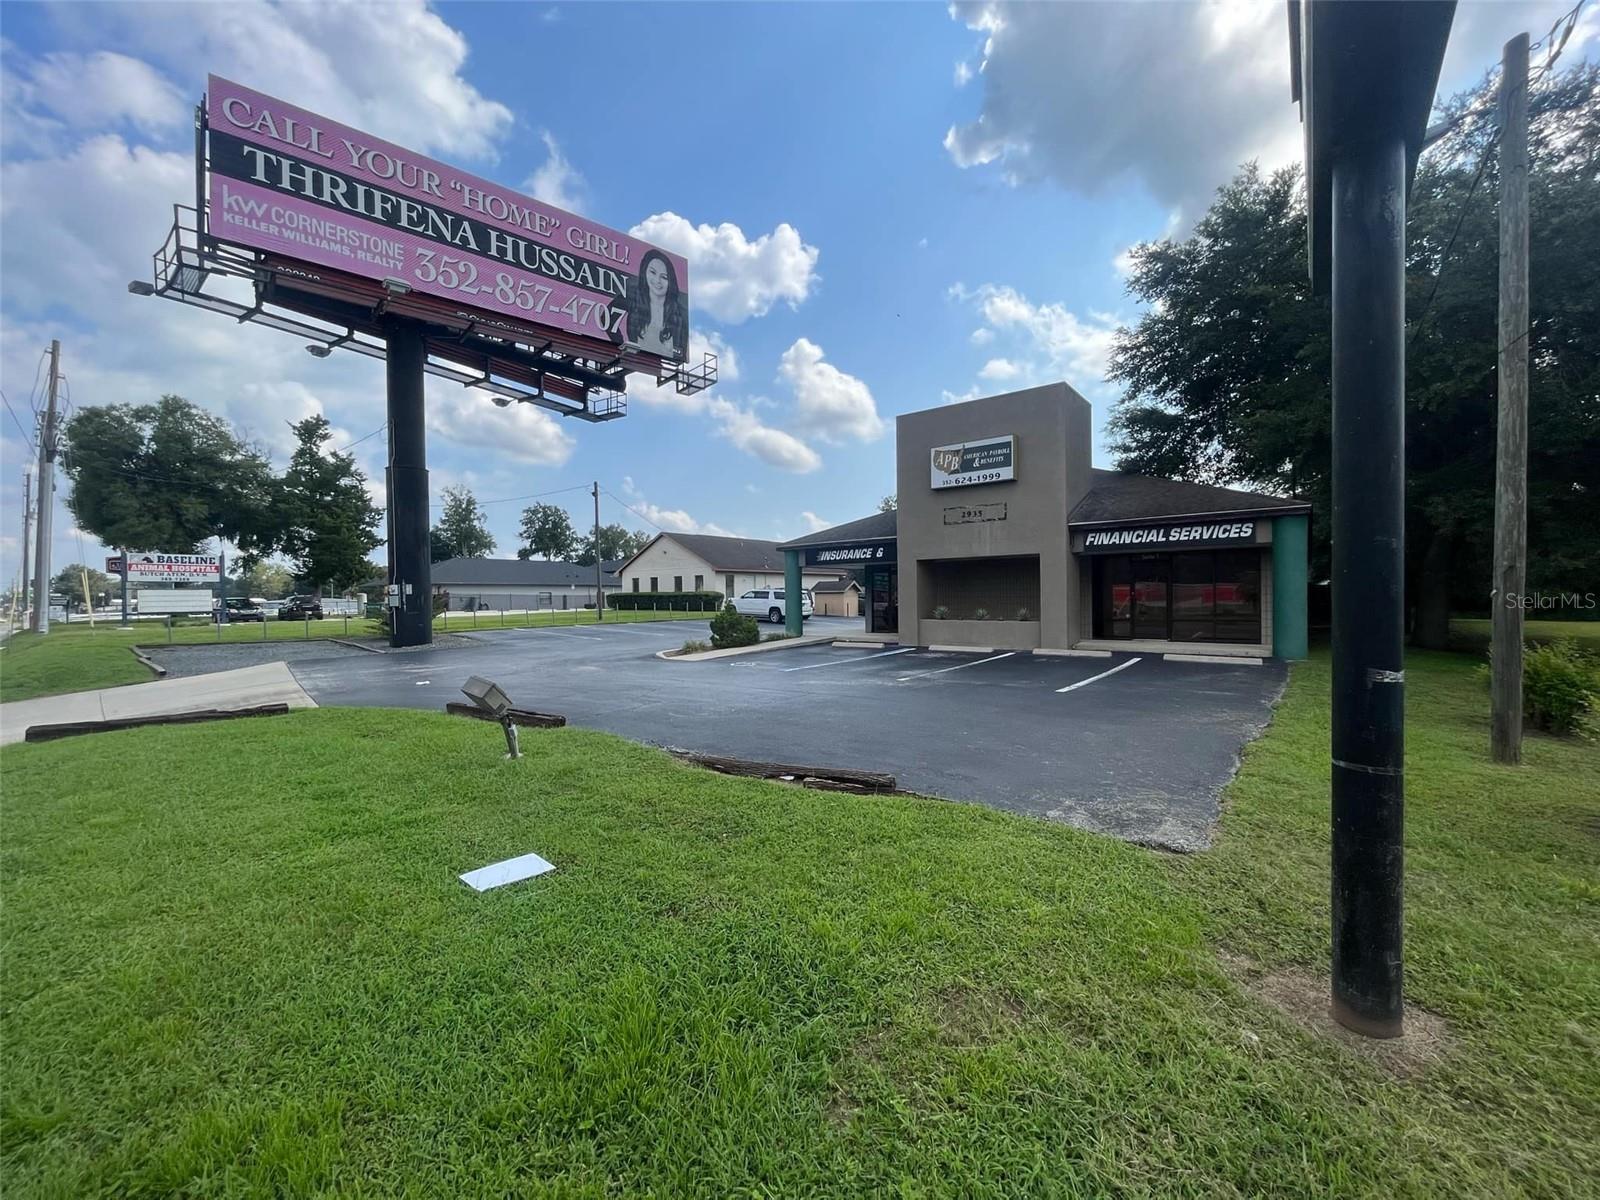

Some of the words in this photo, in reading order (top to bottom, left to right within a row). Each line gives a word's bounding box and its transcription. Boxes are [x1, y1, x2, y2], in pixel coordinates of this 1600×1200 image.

[222, 97, 335, 159] CALL
[342, 138, 445, 199] YOUR
[566, 226, 631, 265] GIRL!
[243, 145, 480, 251] THRIFENA
[487, 228, 630, 299] HUSSAIN
[271, 206, 404, 261] CORNERSTONE
[223, 211, 279, 237] KELLER
[356, 250, 403, 271] REALTY
[415, 247, 628, 334] 352-857-4707
[935, 452, 959, 470] APB
[972, 457, 980, 468] &
[1085, 528, 1167, 546] FINANCIAL
[1169, 522, 1254, 541] SERVICES
[156, 555, 217, 565] BASELINE
[820, 547, 873, 561] INSURANCE
[876, 547, 884, 558] &
[130, 563, 170, 572] ANIMAL
[171, 564, 218, 573] HOSPITAL
